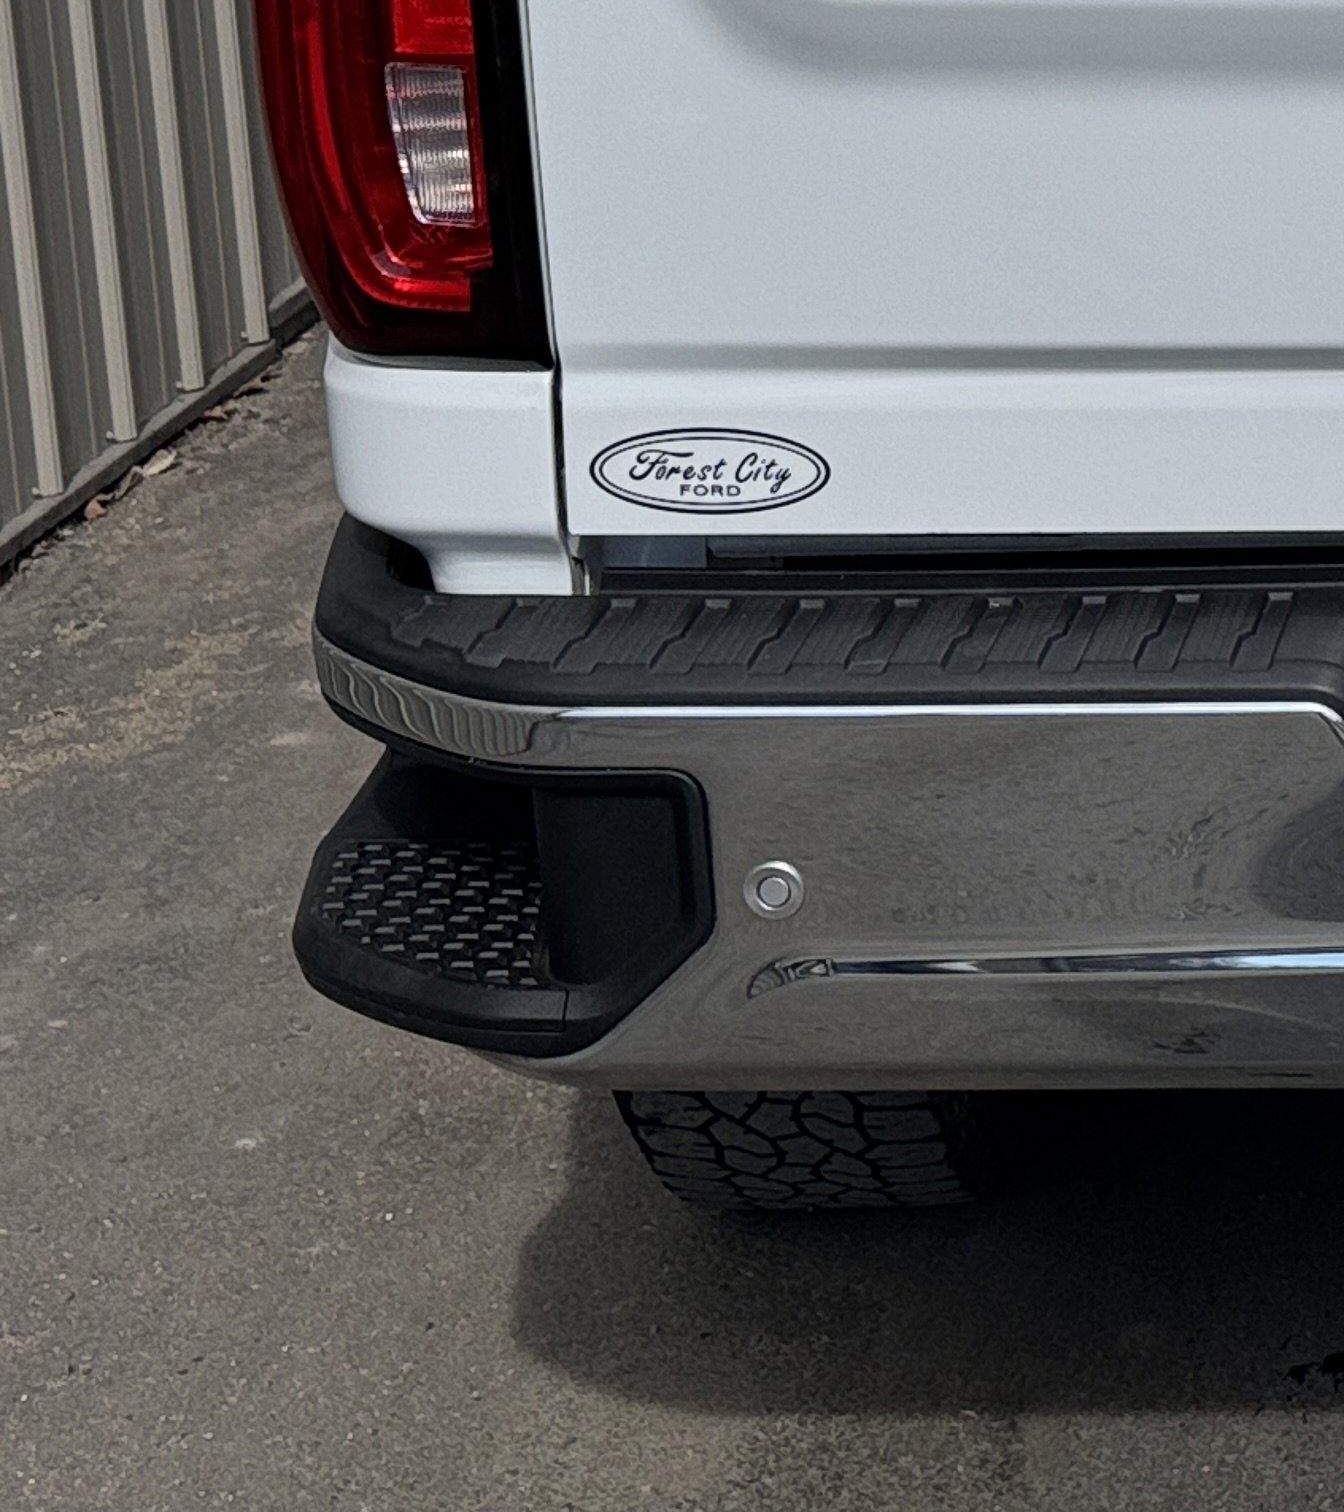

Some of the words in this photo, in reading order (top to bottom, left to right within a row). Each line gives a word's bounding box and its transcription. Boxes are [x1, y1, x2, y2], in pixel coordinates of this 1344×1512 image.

[629, 449, 727, 481] Forest
[735, 452, 791, 494] City
[680, 484, 741, 497] FORD
